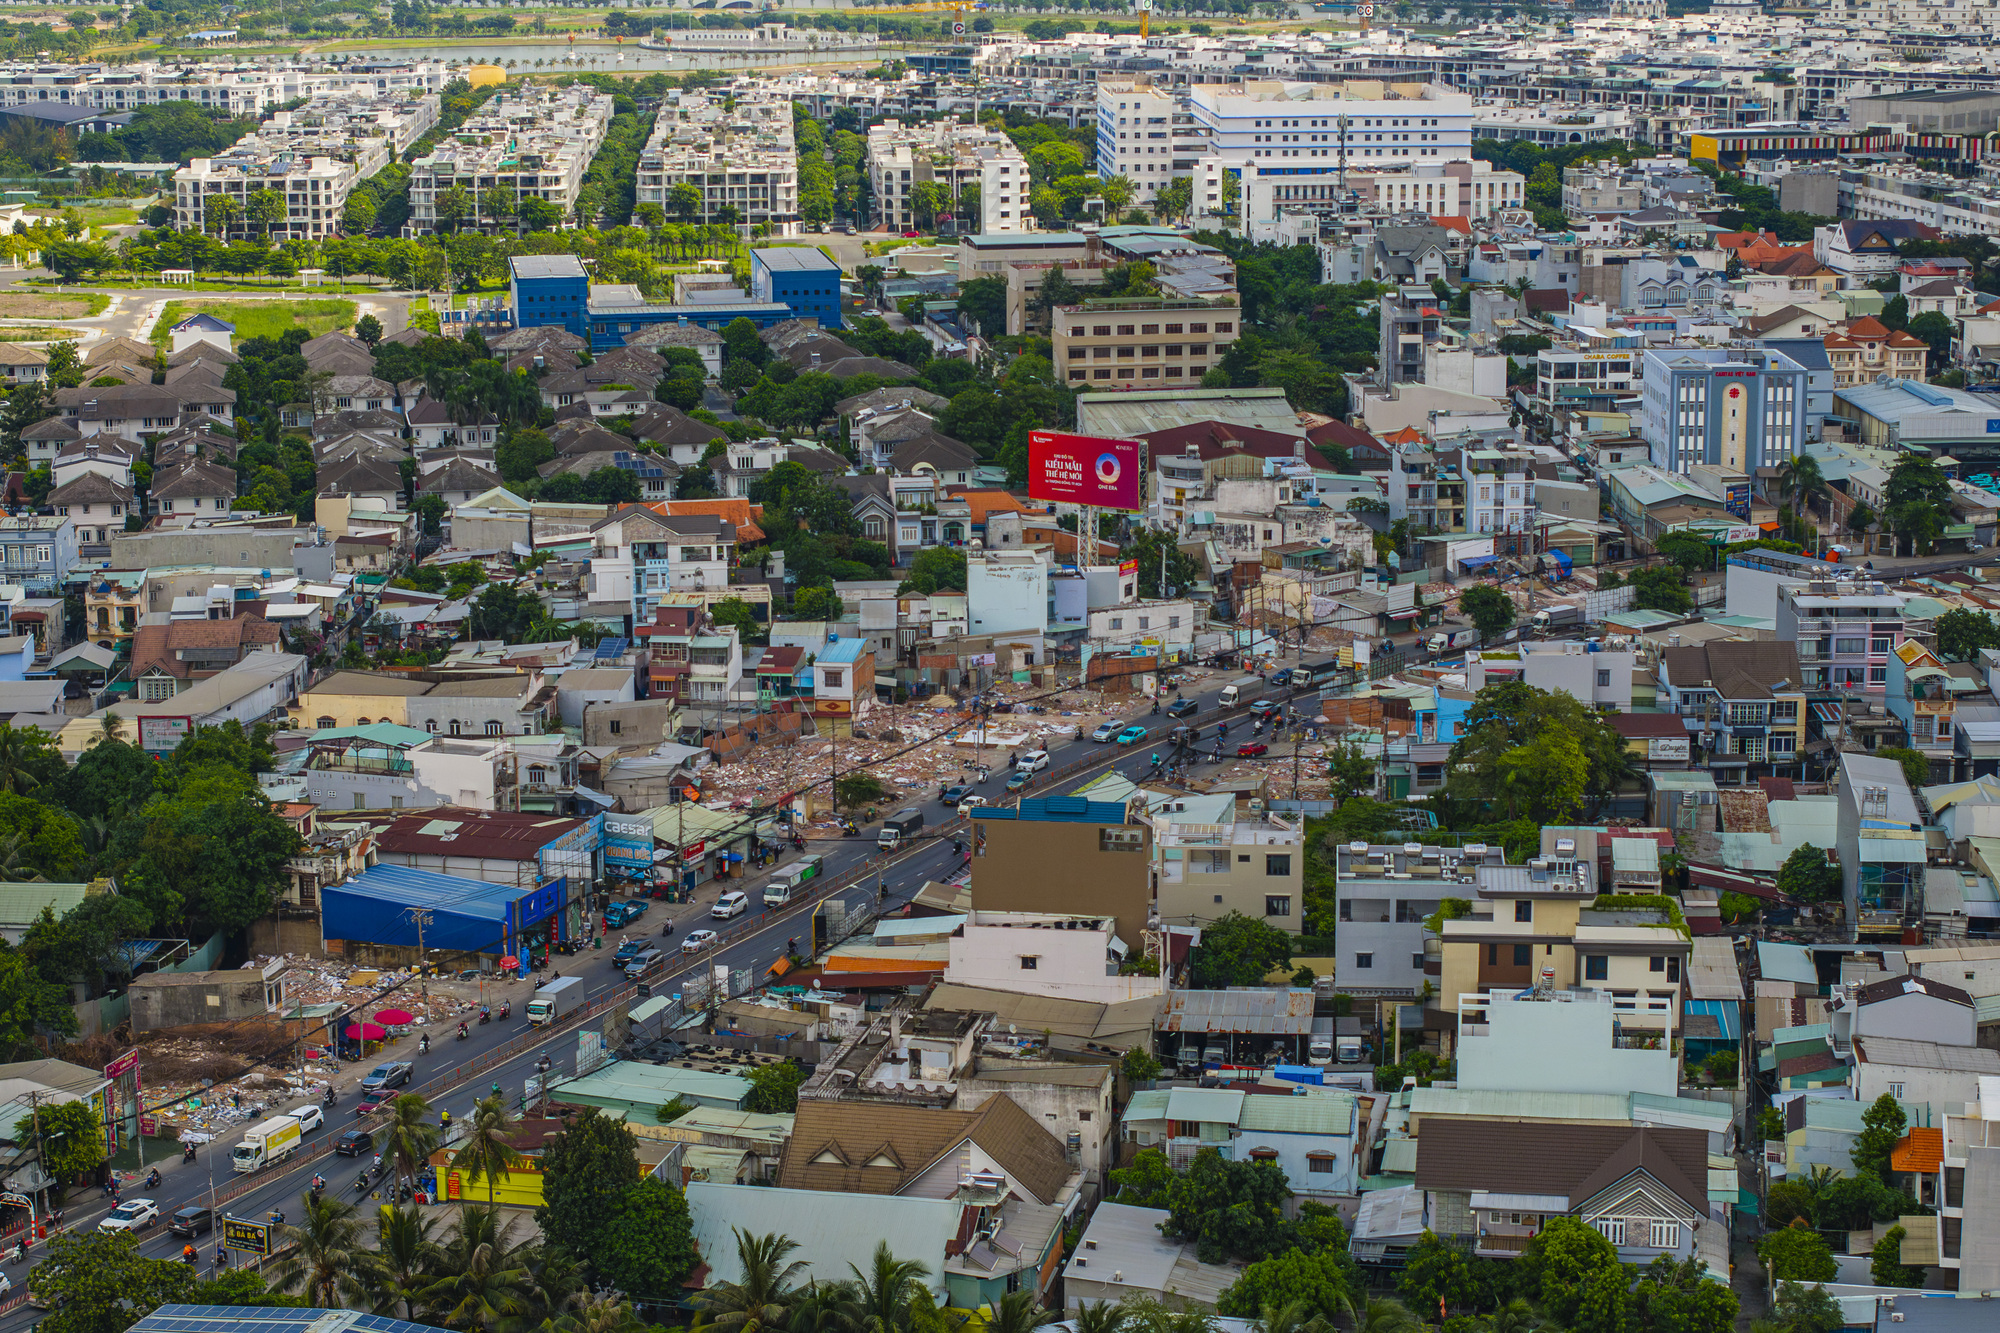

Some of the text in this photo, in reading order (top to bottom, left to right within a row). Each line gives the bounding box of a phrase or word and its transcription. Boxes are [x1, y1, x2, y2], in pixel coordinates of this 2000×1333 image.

[604, 821, 652, 836] caesar
[605, 845, 651, 861] QUANG ĐỨC
